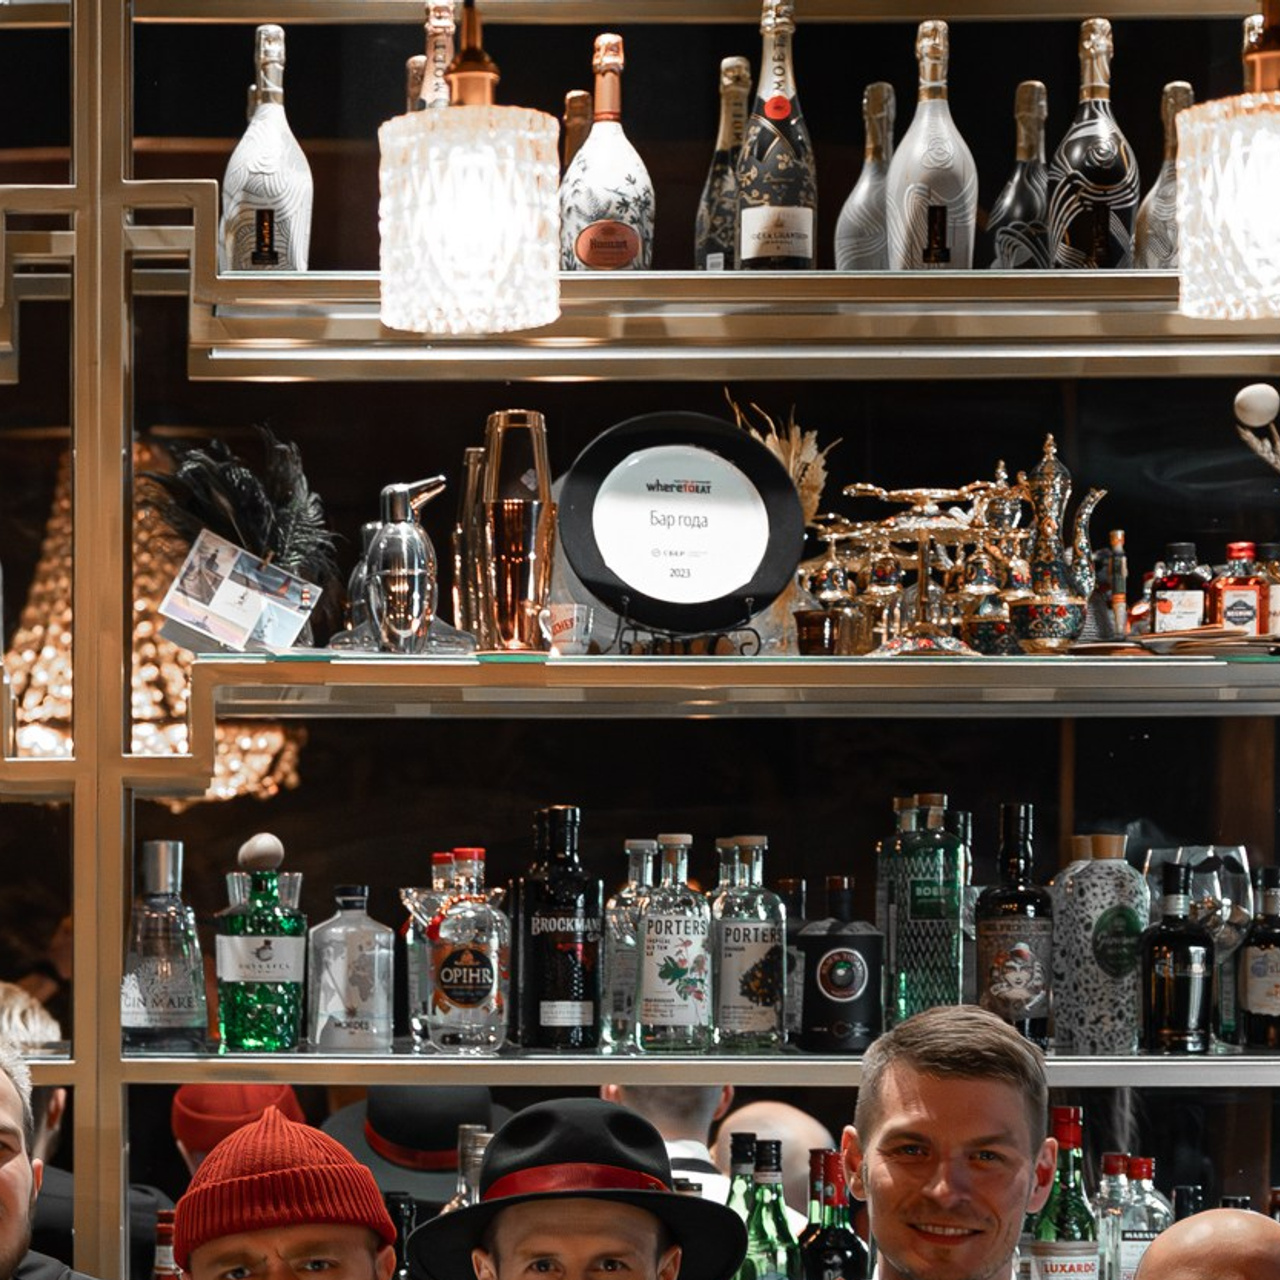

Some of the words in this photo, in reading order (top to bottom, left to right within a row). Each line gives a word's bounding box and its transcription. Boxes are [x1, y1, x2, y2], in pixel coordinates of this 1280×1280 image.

[650, 509, 675, 529] Бар
[678, 514, 709, 529] года
[669, 567, 691, 578] 2023
[646, 918, 708, 936] PORTERS
[724, 926, 784, 944] PORTERS
[440, 967, 494, 984] OPIHR
[1043, 1262, 1097, 1274] LUXARDO
